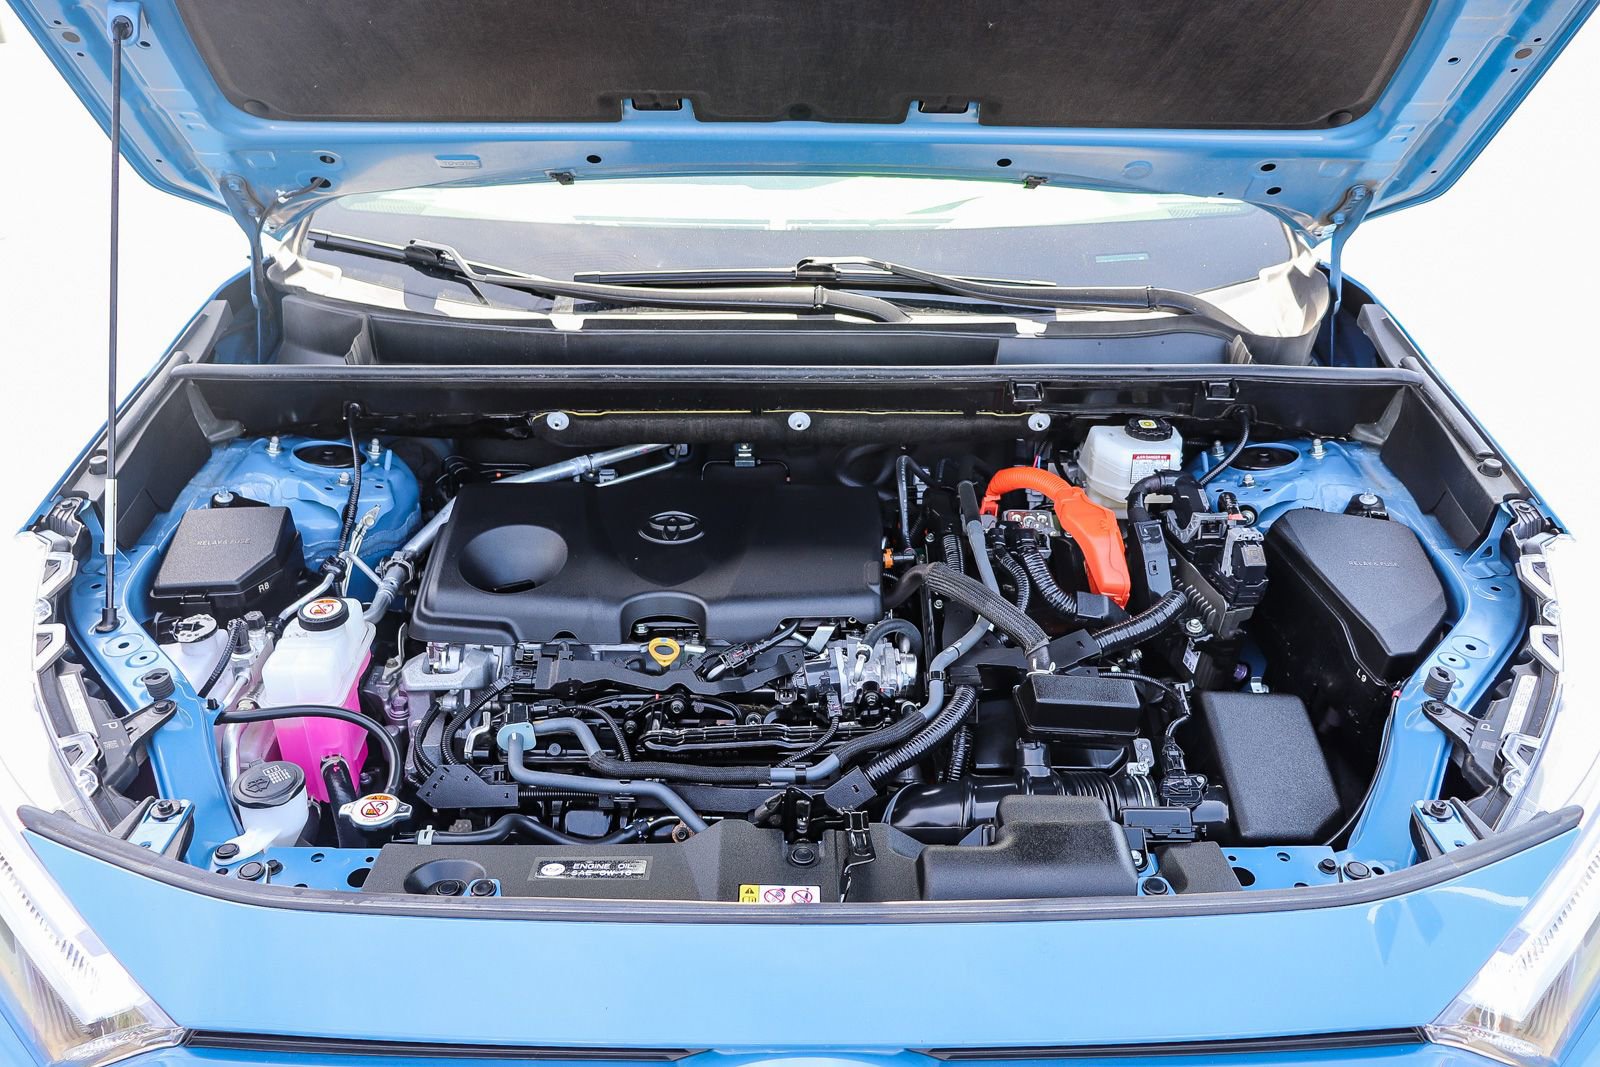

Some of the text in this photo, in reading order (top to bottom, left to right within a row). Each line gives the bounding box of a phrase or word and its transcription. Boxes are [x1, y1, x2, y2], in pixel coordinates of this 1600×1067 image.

[258, 581, 270, 593] R8
[572, 862, 612, 870] ENGINE
[617, 862, 634, 870] OIL
